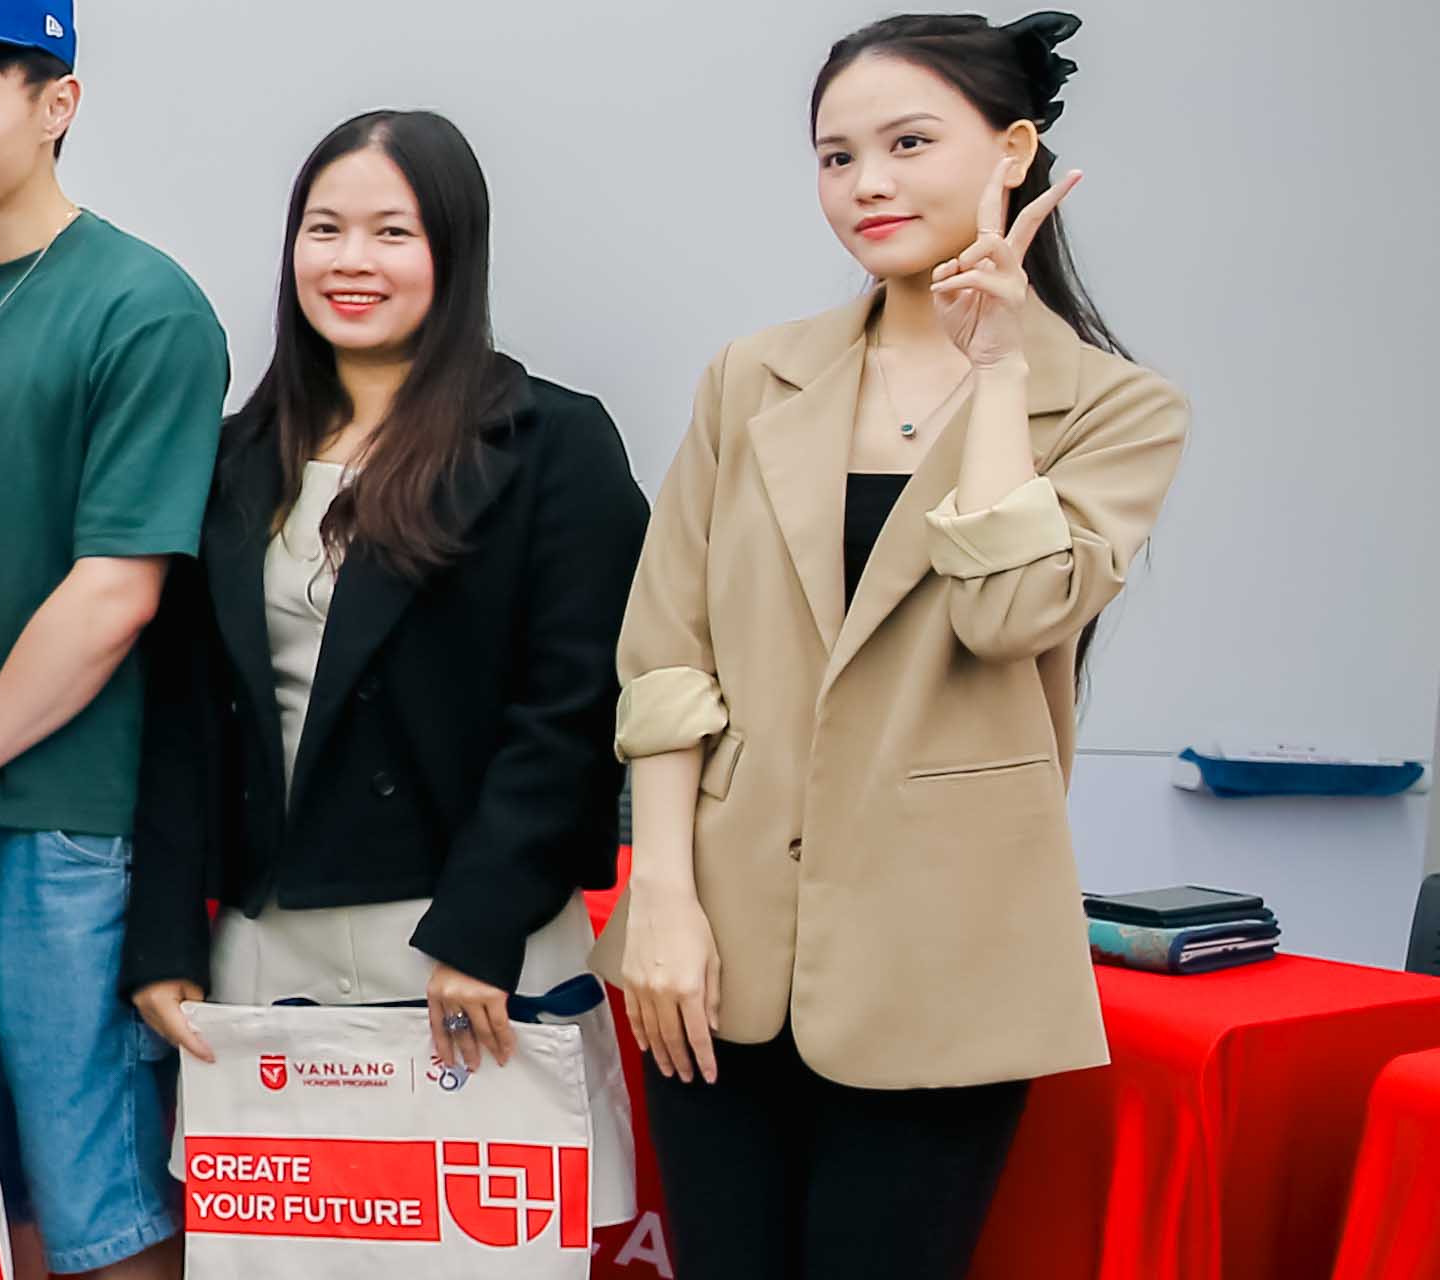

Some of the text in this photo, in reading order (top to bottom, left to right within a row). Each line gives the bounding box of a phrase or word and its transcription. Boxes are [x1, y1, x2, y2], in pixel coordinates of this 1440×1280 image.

[293, 1062, 395, 1076] VANLANG
[189, 1153, 311, 1183] CREATE
[192, 1193, 423, 1227] YOUR FUTURE
